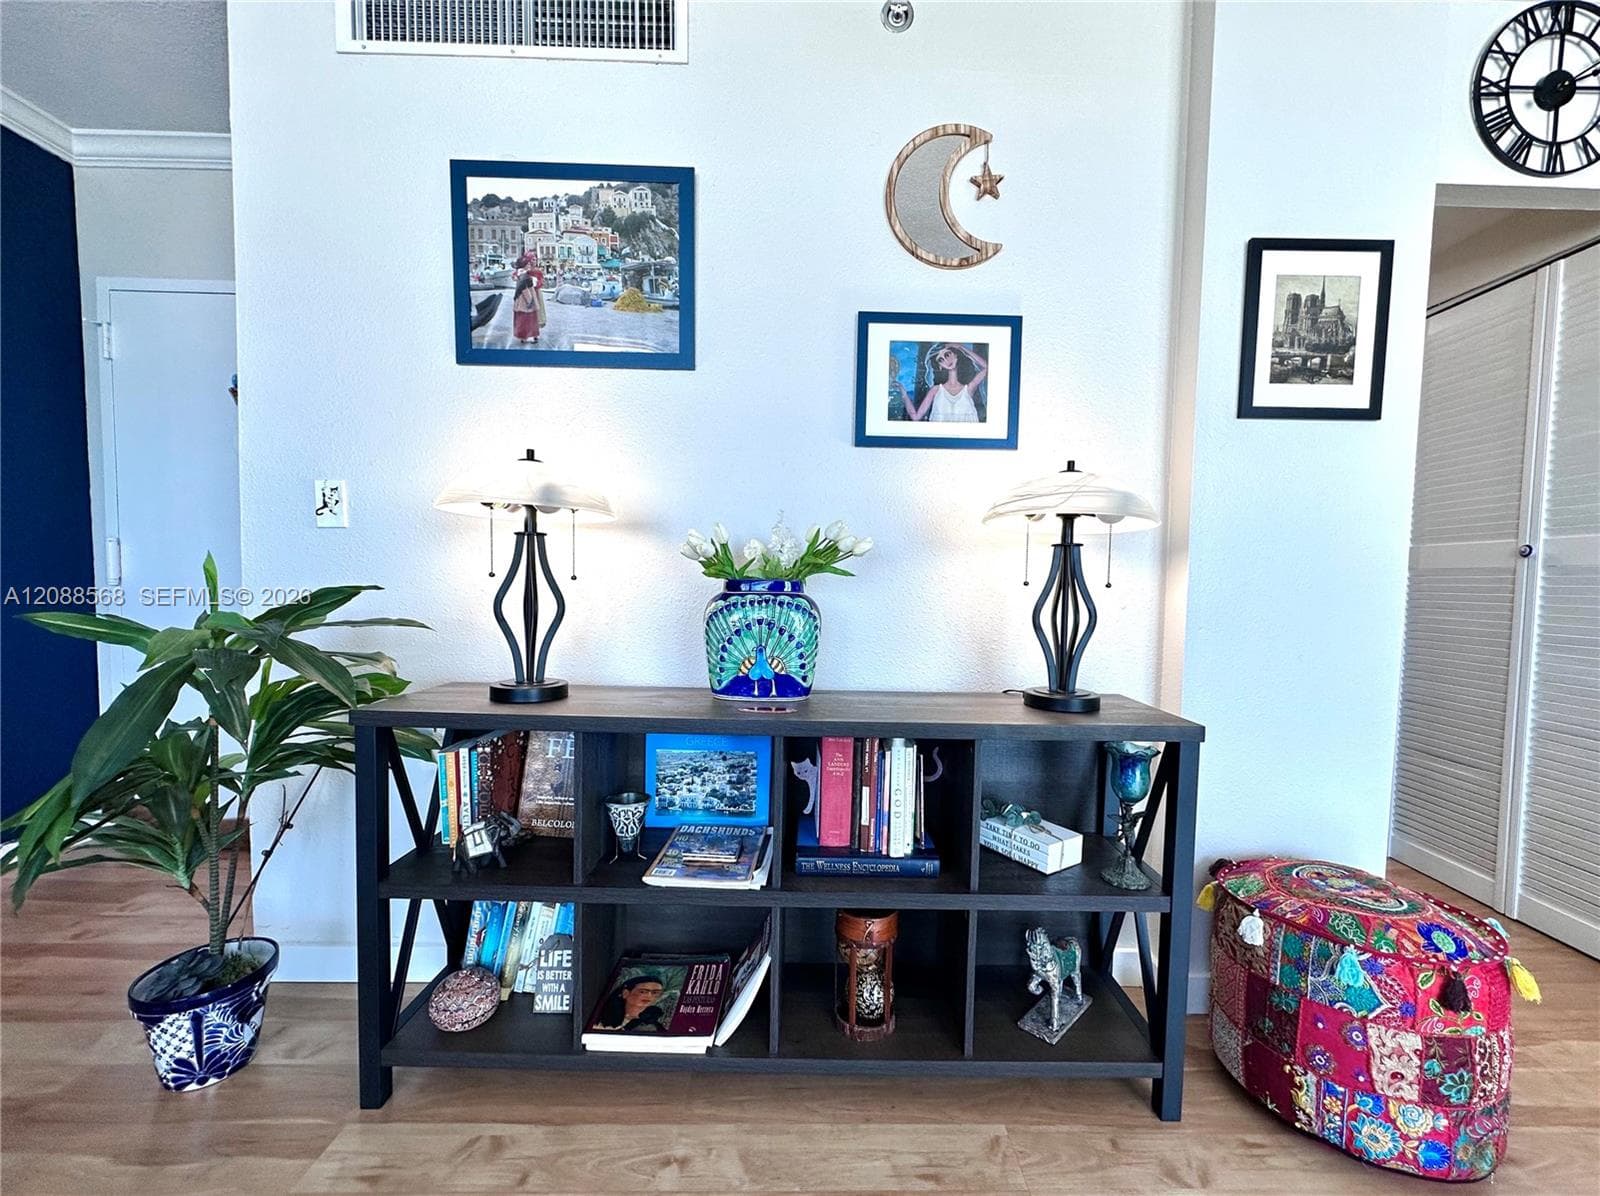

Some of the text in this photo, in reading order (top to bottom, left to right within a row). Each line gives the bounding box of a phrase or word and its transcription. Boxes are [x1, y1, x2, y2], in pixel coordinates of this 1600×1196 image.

[679, 825, 756, 837] DACHSHUNDS
[986, 822, 1000, 835] TAKE
[1019, 835, 1029, 846] TO
[1029, 841, 1040, 851] DO
[801, 862, 815, 870] THE
[539, 949, 573, 968] LIFE
[536, 970, 572, 981] IS BETTER
[690, 964, 723, 980] FRIDA
[542, 983, 566, 993] WITH A
[685, 980, 721, 995] KAHLO
[534, 995, 570, 1011] SMILE
